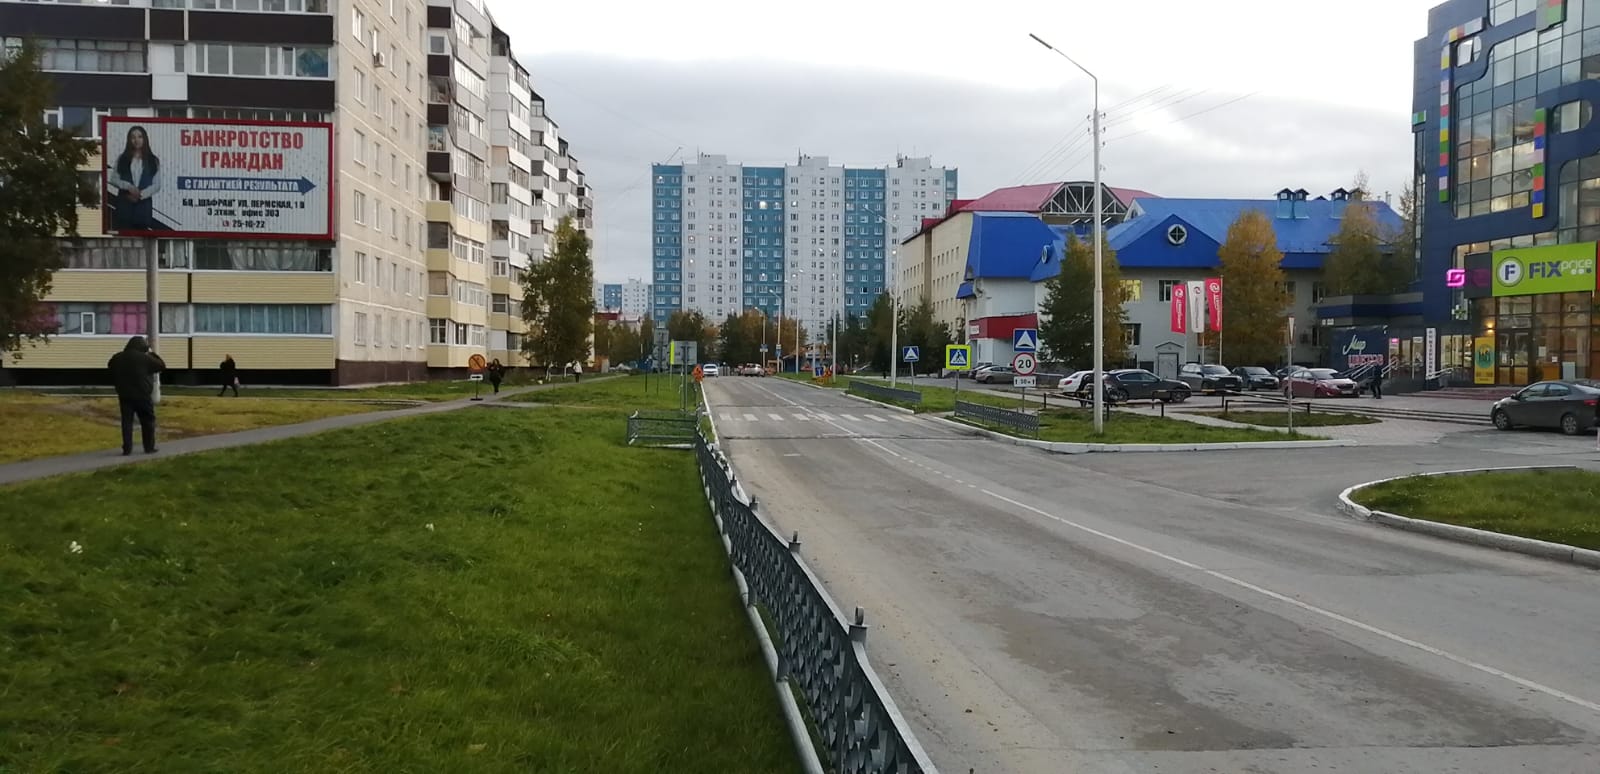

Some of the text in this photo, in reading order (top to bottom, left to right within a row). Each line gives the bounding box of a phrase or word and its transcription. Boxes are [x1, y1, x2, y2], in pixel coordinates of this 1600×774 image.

[180, 129, 304, 149] БАНКРОТСТВО
[201, 151, 283, 172] ГРАЖДАН
[184, 177, 299, 192] С ГАРАНТИЕЙ РЕЗУЛЬТАТА
[1018, 359, 1032, 369] 20
